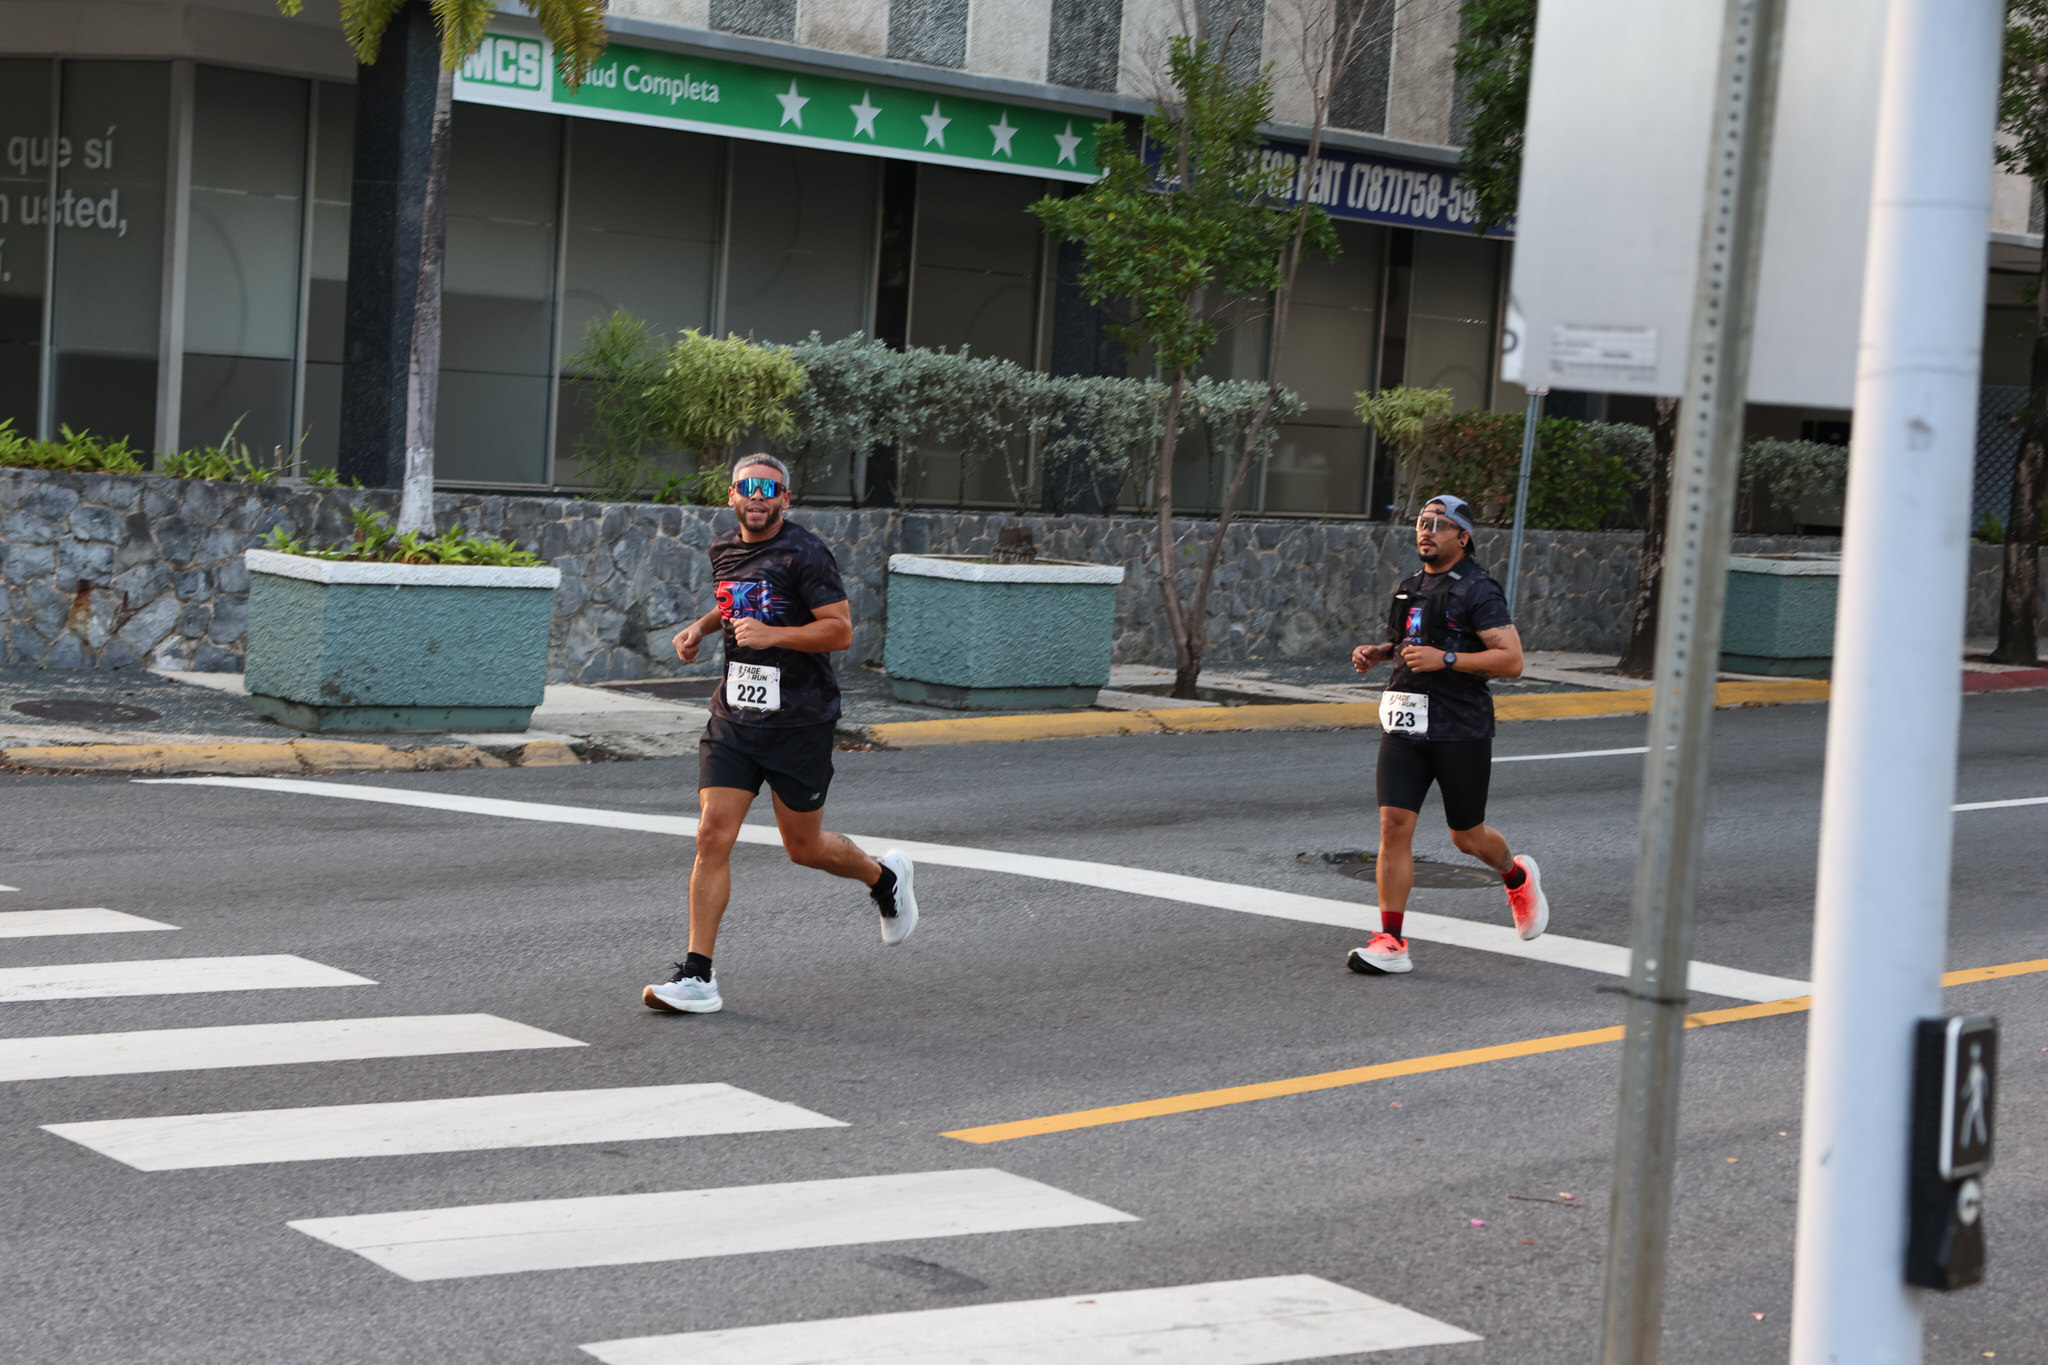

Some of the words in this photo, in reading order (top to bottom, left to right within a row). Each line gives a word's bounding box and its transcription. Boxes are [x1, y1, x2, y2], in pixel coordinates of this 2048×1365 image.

[463, 38, 541, 87] MCS
[623, 64, 720, 105] Completa
[8, 136, 72, 175] que
[84, 125, 117, 169] sí
[1347, 163, 1480, 224] (787)758-59
[715, 580, 757, 609] 5K
[737, 684, 767, 704] 222
[751, 674, 768, 682] RUN
[1388, 710, 1415, 727] 123
